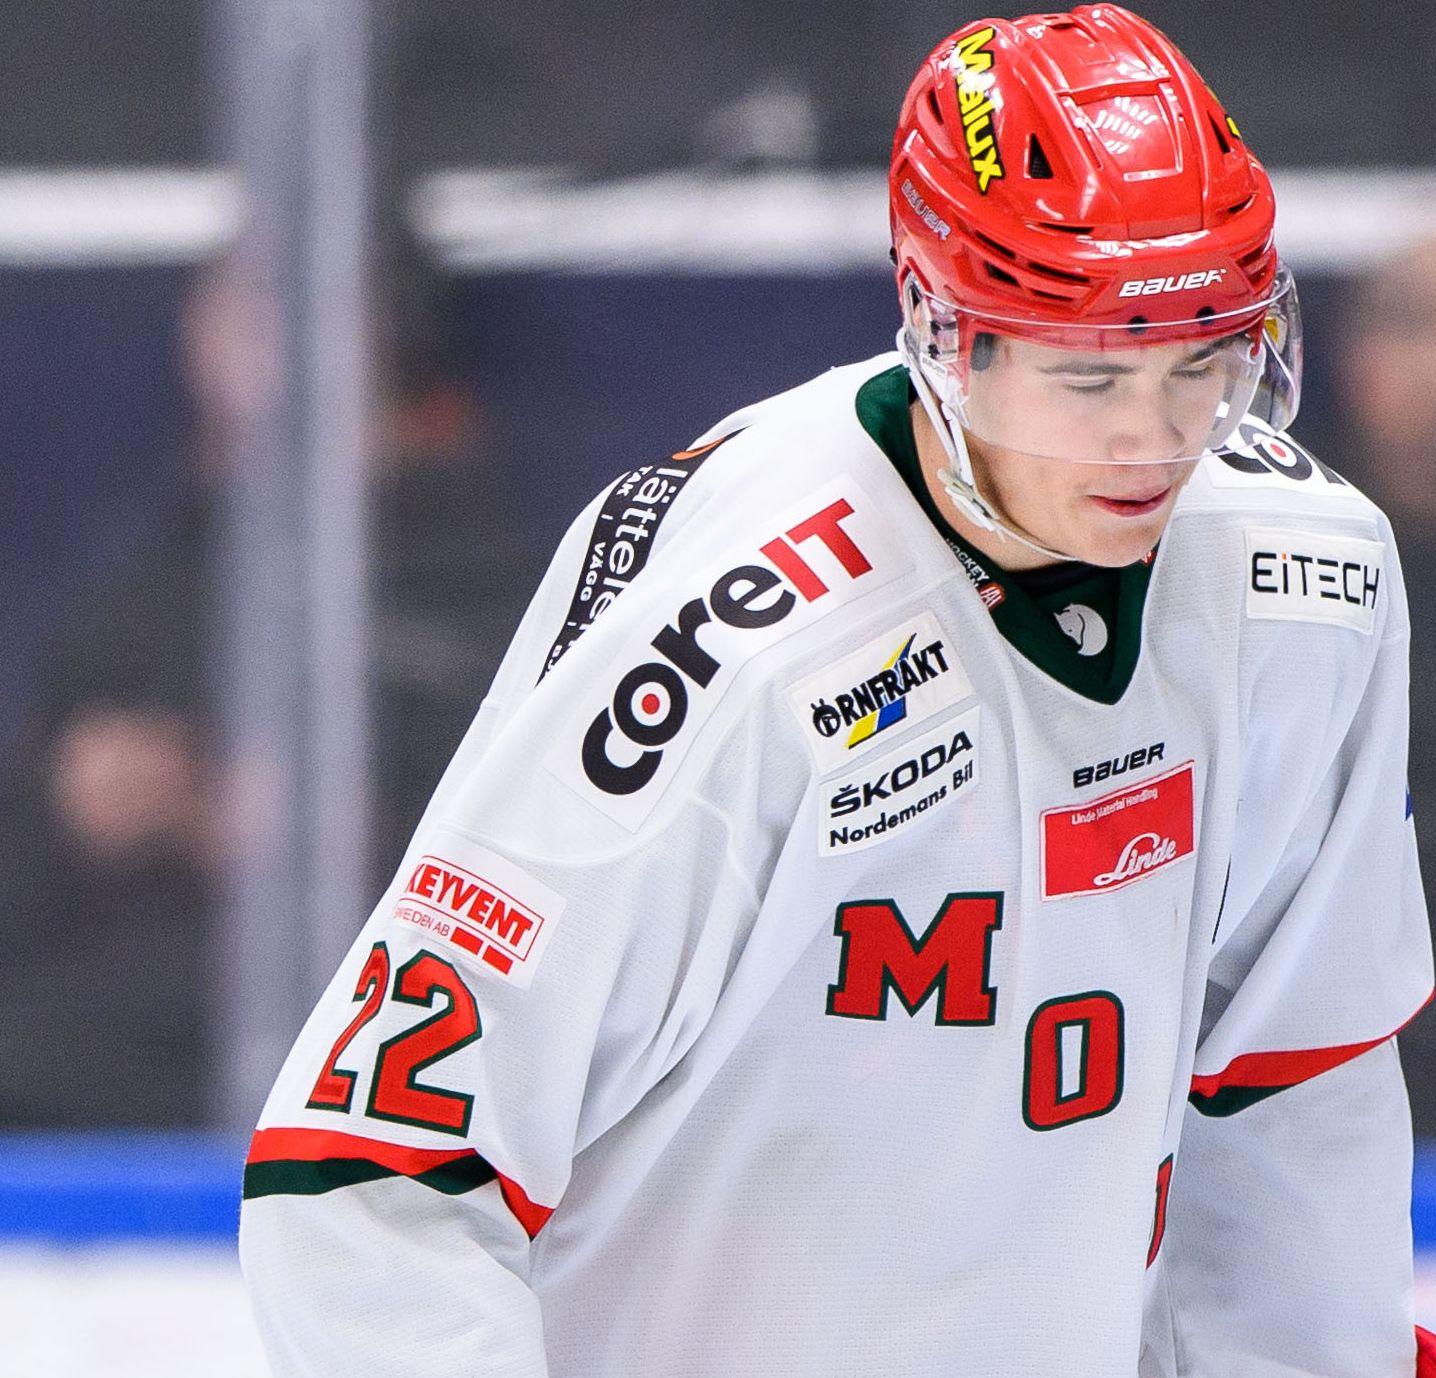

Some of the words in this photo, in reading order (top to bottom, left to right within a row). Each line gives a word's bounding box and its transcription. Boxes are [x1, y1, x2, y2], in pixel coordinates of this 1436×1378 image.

[956, 27, 1003, 193] Malux
[1118, 268, 1226, 298] BAUER
[581, 497, 873, 795] coreIT
[829, 785, 947, 848] Nordemans
[952, 759, 973, 791] Bil
[830, 731, 973, 818] ŠKODA
[1072, 742, 1165, 789] BAUER
[1092, 832, 1177, 886] Linde
[305, 940, 483, 1139] 22
